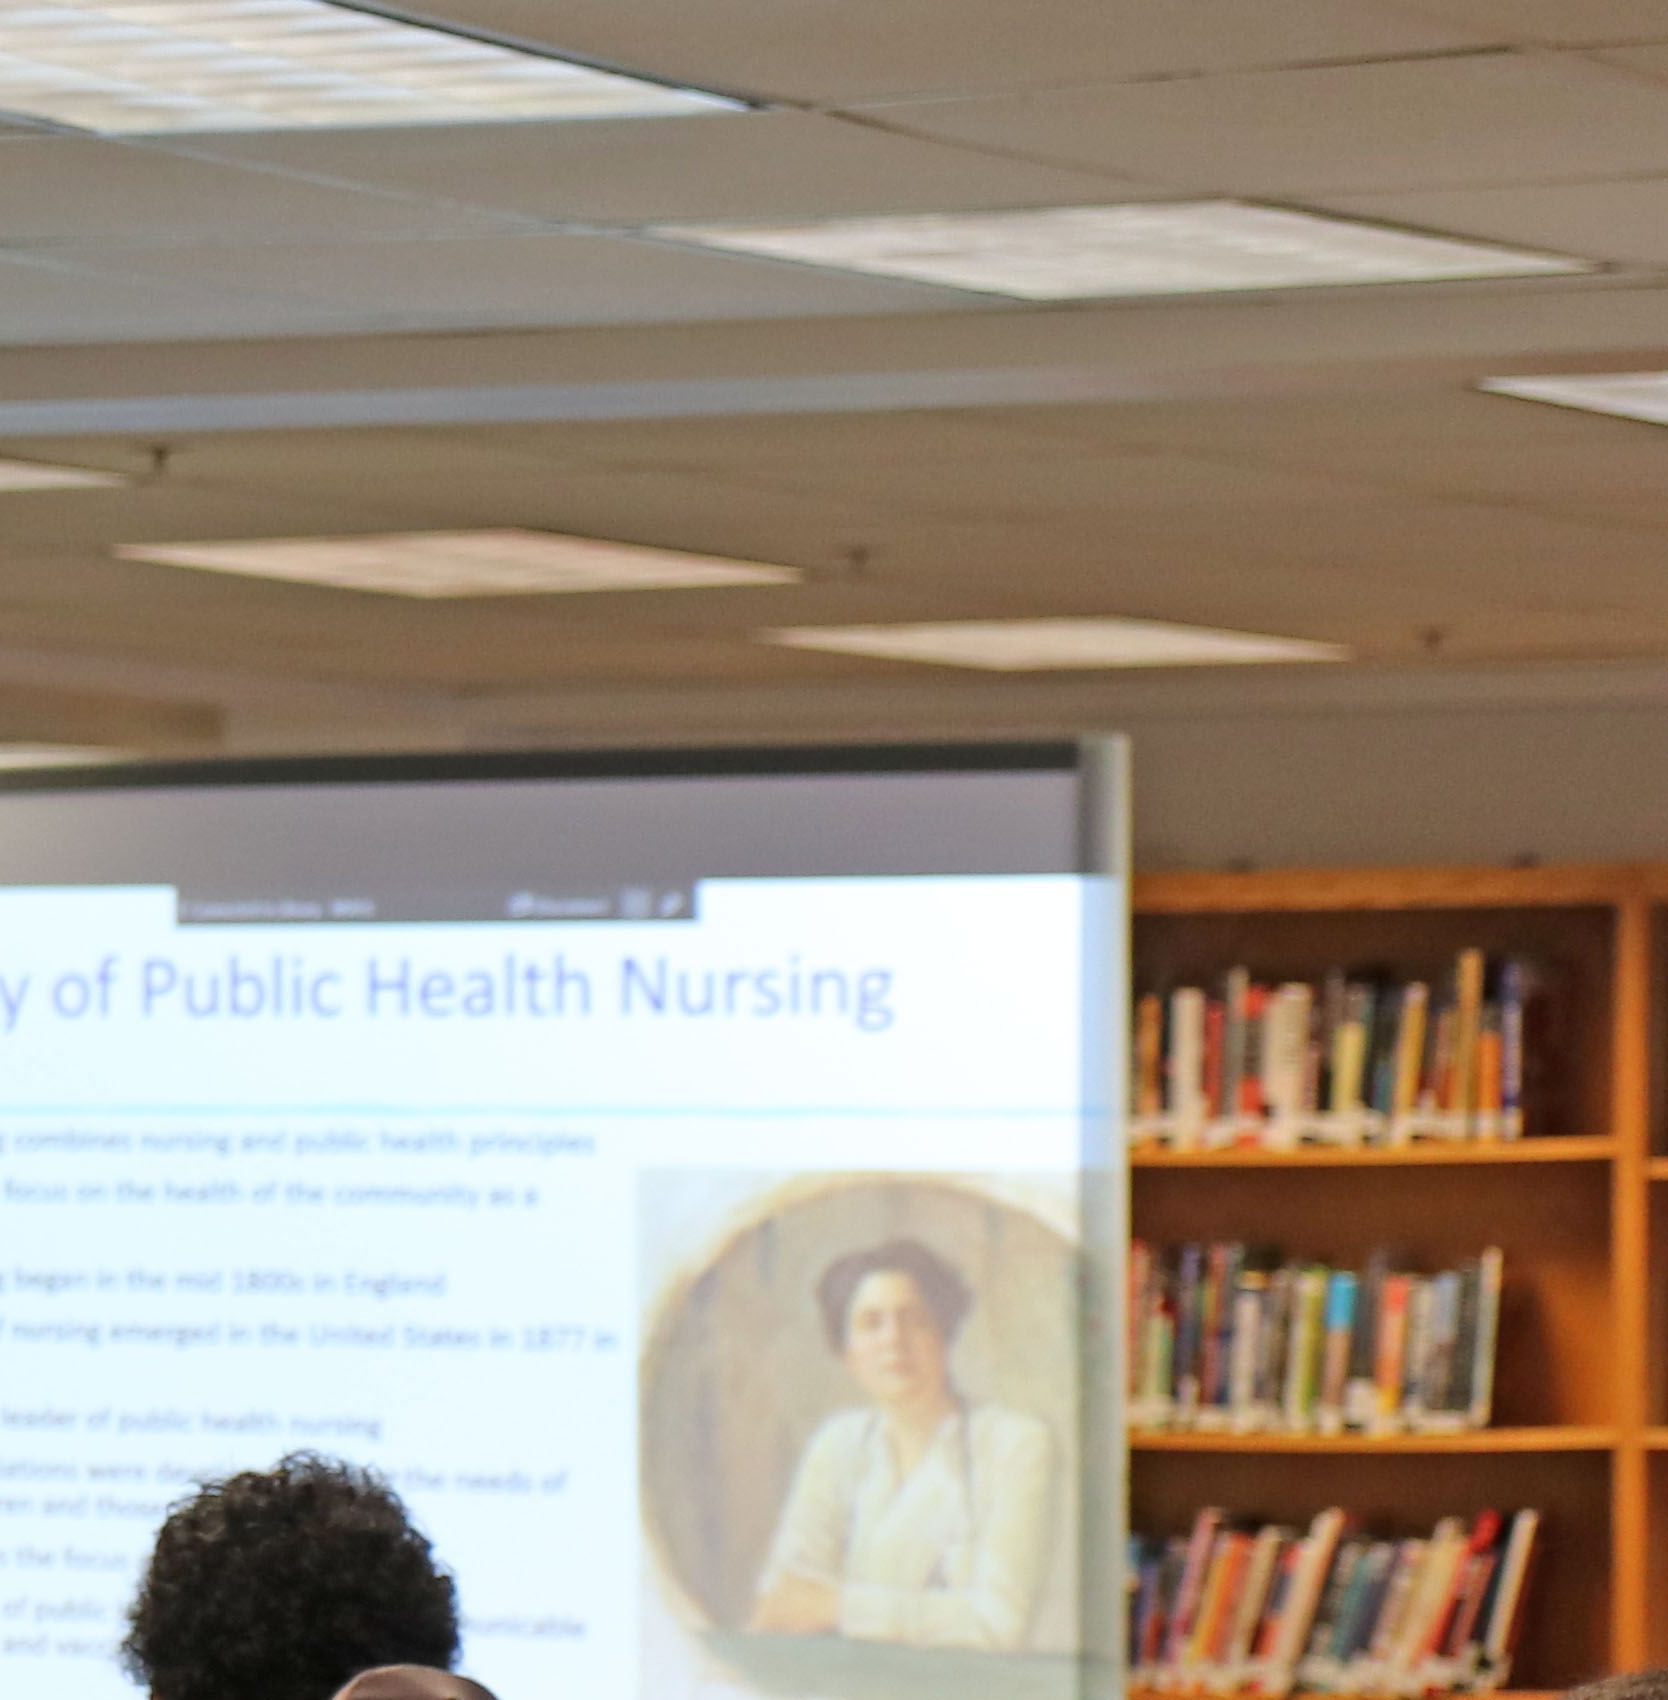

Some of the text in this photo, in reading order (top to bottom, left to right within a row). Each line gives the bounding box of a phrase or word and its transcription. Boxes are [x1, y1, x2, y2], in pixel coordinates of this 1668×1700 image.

[51, 953, 120, 1018] of
[141, 955, 342, 1018] Public
[366, 953, 593, 1018] Health
[619, 954, 894, 1032] Nursing
[140, 1132, 230, 1158] nursing
[241, 1131, 285, 1153] and
[294, 1131, 368, 1155] public
[380, 1131, 459, 1153] health
[76, 1184, 107, 1203] on
[115, 1180, 154, 1202] the
[163, 1181, 240, 1203] health
[251, 1181, 278, 1203] of
[285, 1182, 325, 1204] the
[334, 1184, 478, 1210] community
[488, 1188, 514, 1206] as
[523, 1188, 538, 1207] a
[14, 1268, 87, 1295] began
[96, 1270, 118, 1290] in
[126, 1270, 165, 1292] the
[313, 1274, 335, 1293] in
[344, 1272, 445, 1300] England
[12, 1322, 102, 1348] nursing
[228, 1325, 249, 1343] in
[260, 1324, 299, 1345] the
[309, 1325, 394, 1348] United
[404, 1325, 478, 1349] States
[490, 1329, 512, 1349] in
[594, 1330, 615, 1350] in
[2, 1406, 76, 1430] leader
[87, 1408, 113, 1430] of
[117, 1410, 191, 1434] public
[200, 1411, 281, 1433] health
[291, 1416, 381, 1442] nursing
[88, 1465, 145, 1482] were
[410, 1469, 446, 1490] the
[457, 1471, 531, 1493] needs
[540, 1471, 567, 1493] of
[42, 1496, 87, 1517] and
[16, 1547, 54, 1569] the
